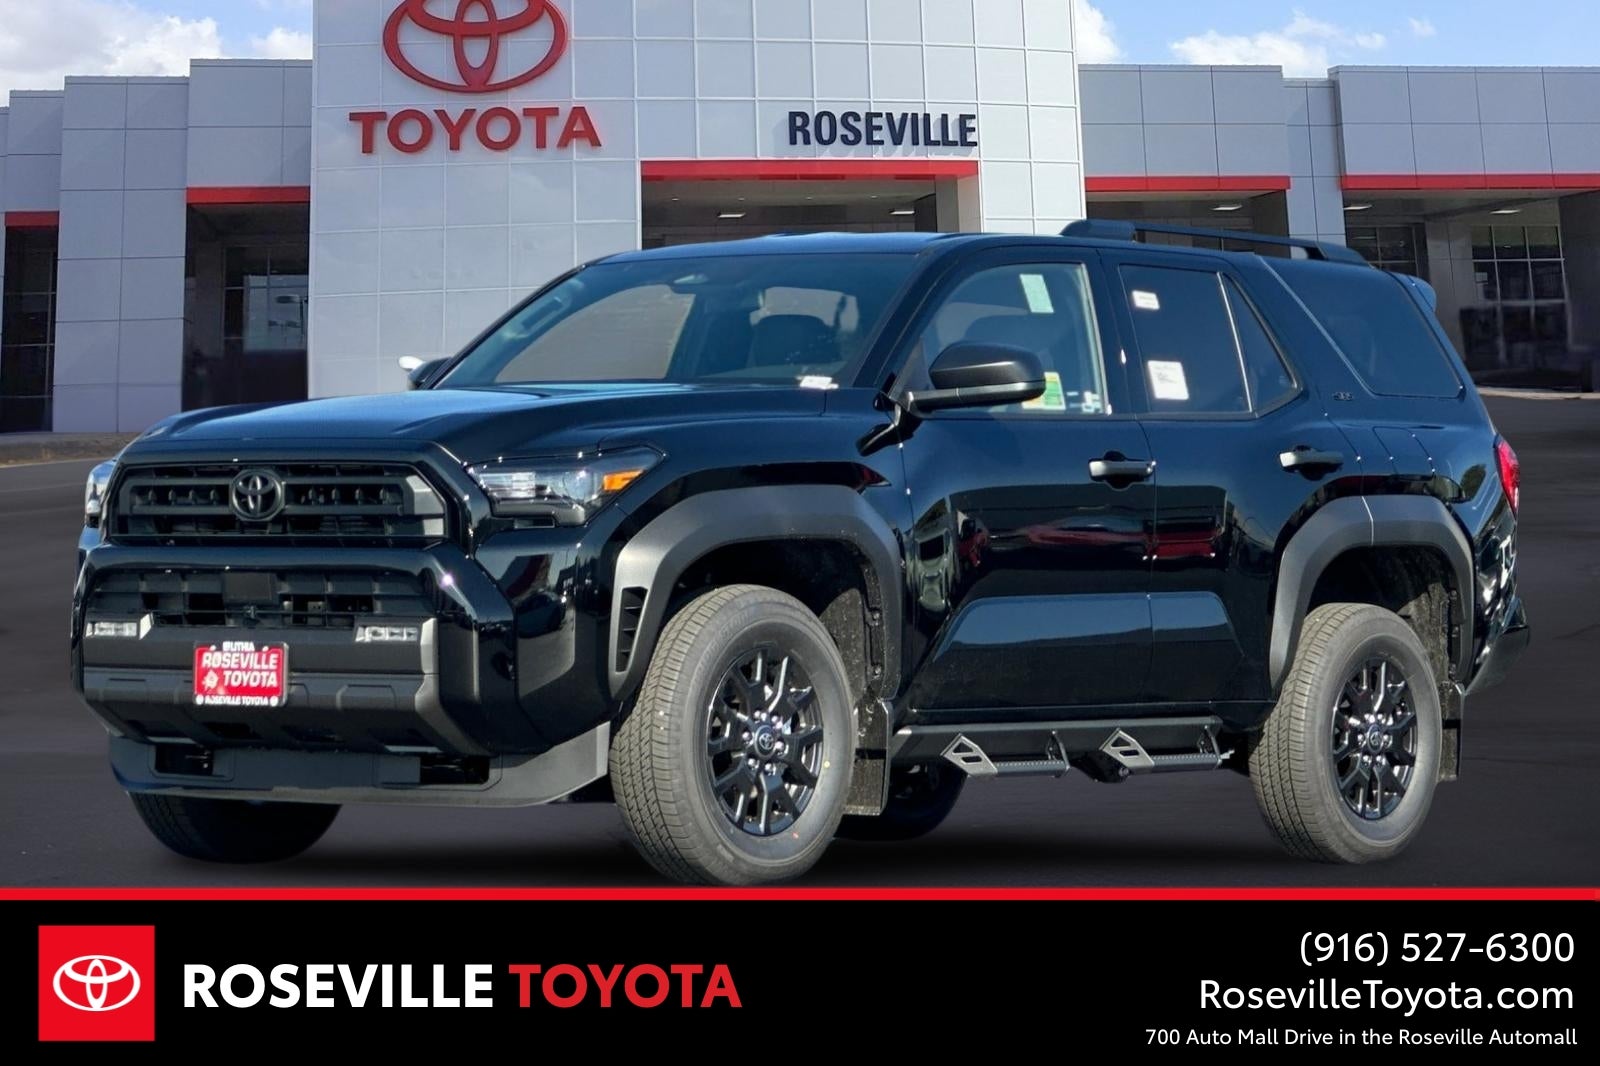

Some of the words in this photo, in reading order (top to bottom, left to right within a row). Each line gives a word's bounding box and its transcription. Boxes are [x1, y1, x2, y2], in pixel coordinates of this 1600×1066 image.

[349, 106, 602, 154] TOYOTA
[788, 111, 978, 148] ROSEVILLE
[231, 641, 255, 651] LITHIA
[202, 652, 279, 669] ROSEVILLE
[223, 670, 278, 687] TOYOTA
[205, 695, 240, 705] ROSEVILLE
[242, 696, 268, 705] TOYOTA
